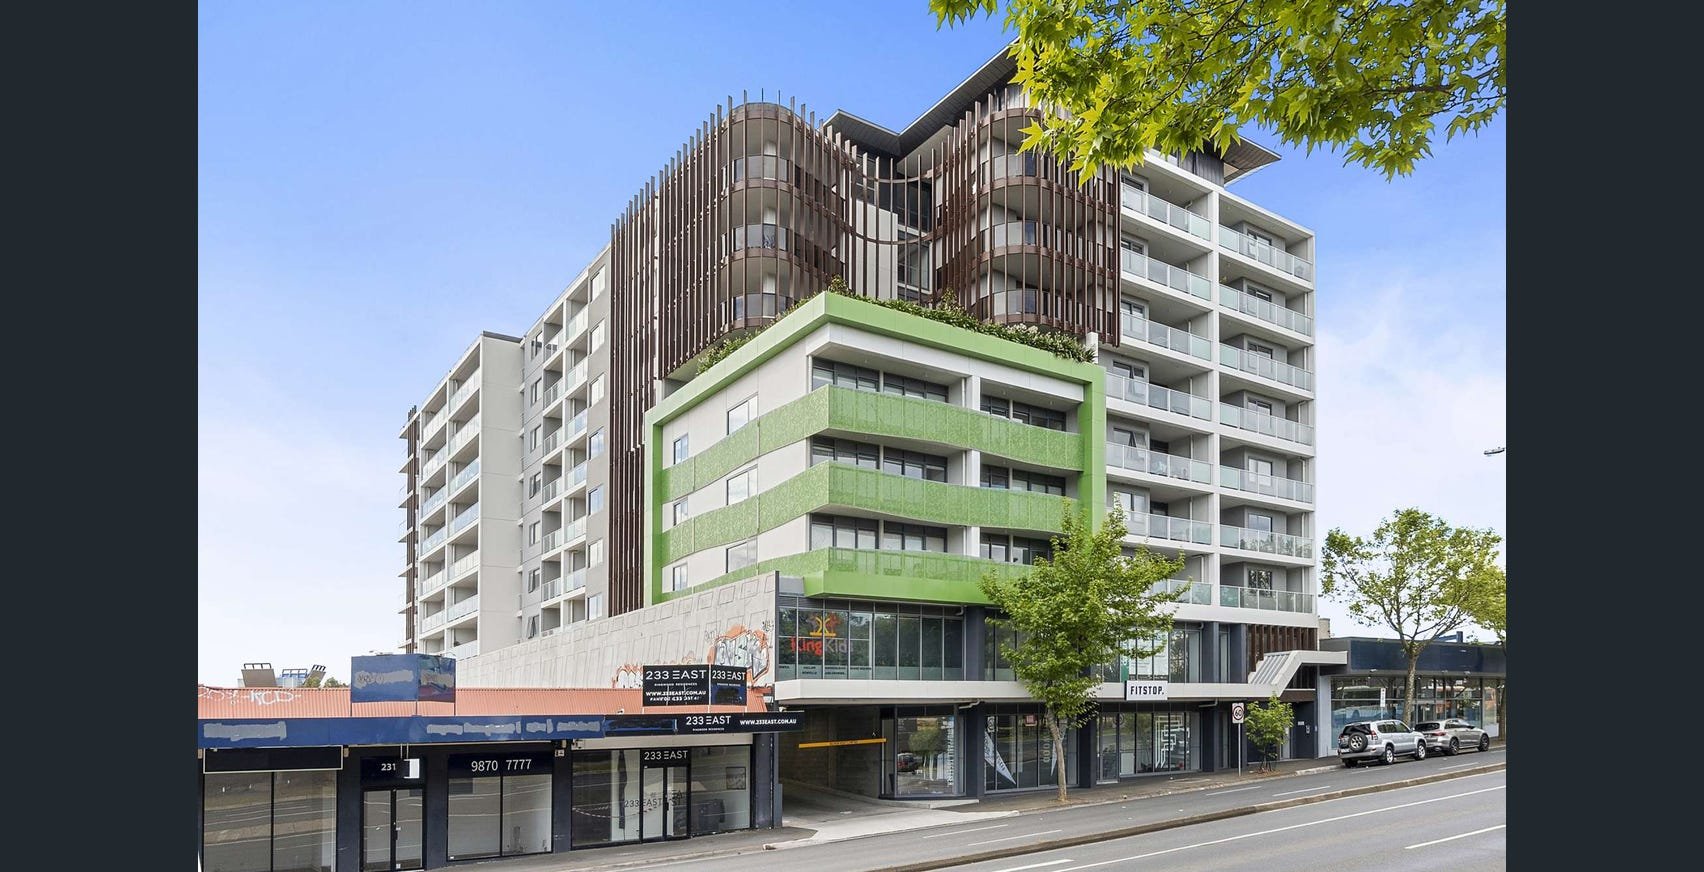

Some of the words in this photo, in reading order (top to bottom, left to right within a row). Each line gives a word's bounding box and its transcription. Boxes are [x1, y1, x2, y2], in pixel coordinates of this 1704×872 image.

[645, 670, 670, 680] 233
[672, 669, 707, 680] EAST
[712, 670, 726, 680] 233
[727, 671, 746, 681] EAST
[1235, 709, 1243, 717] 60
[686, 716, 704, 725] 233
[706, 715, 731, 725] EAST
[644, 751, 662, 760] 233
[663, 750, 688, 759] EAST
[381, 763, 396, 771] 231
[471, 760, 499, 772] 9870
[505, 759, 532, 771] 7777
[624, 799, 640, 808] 233
